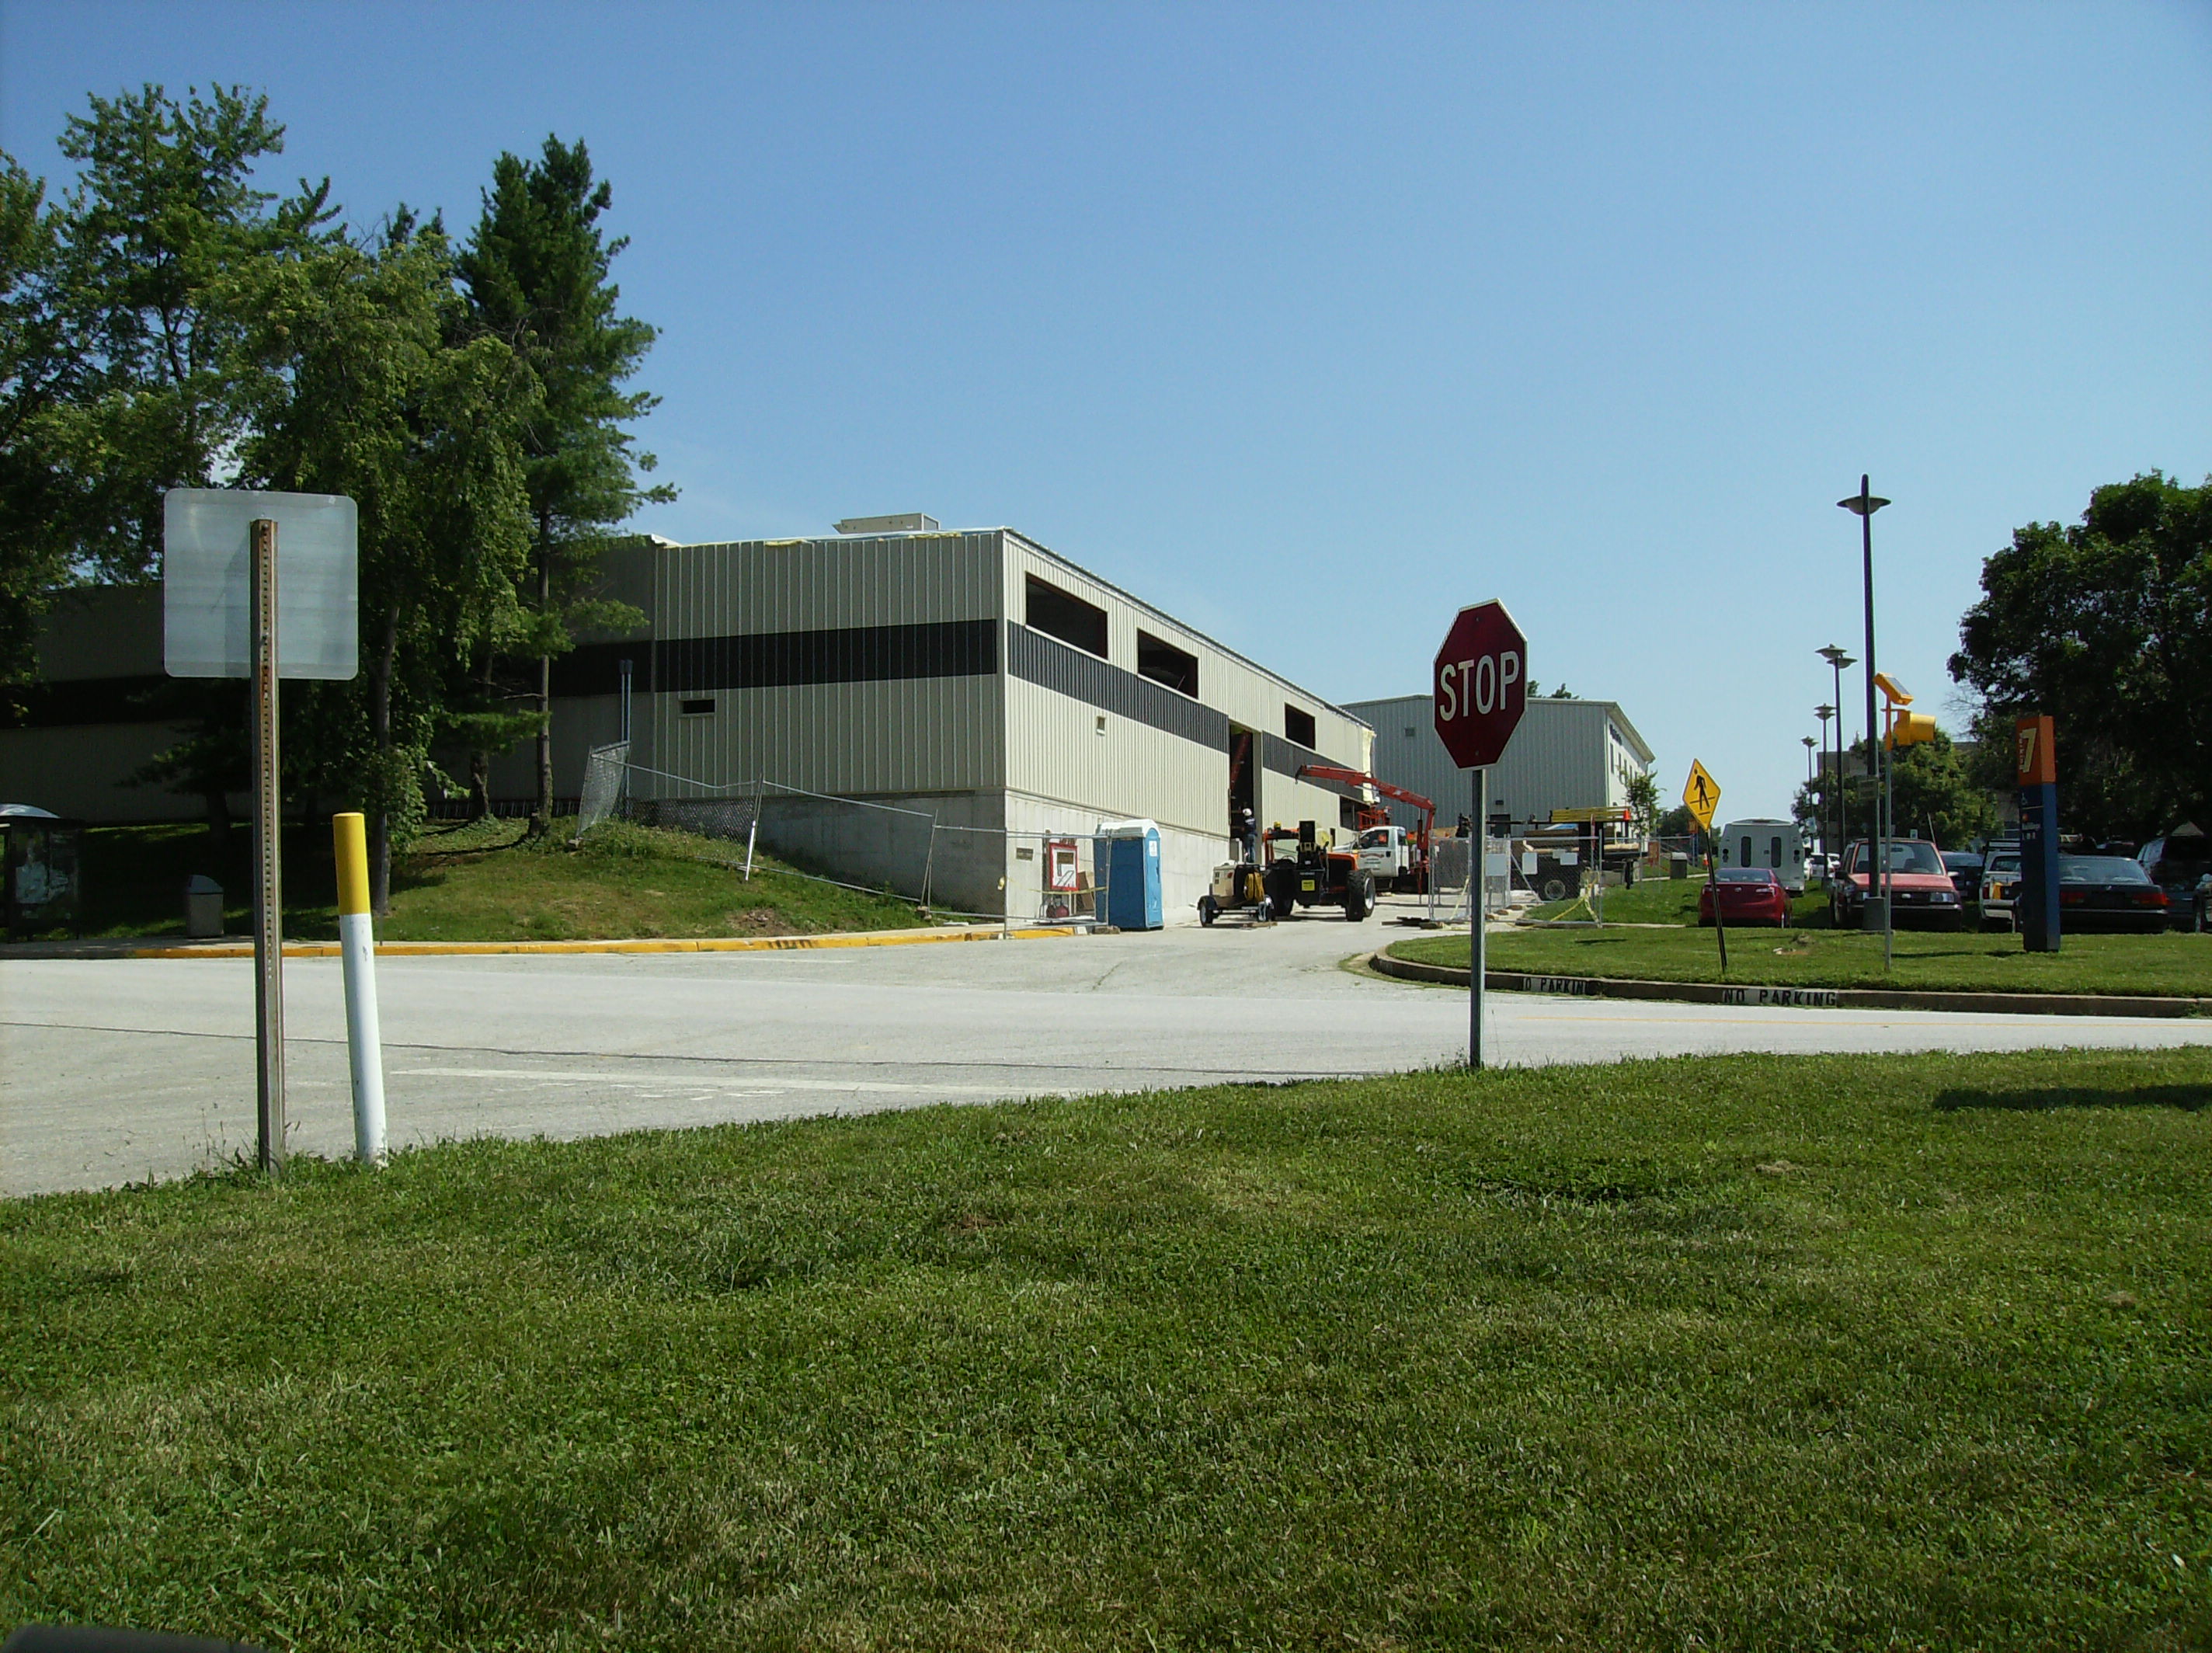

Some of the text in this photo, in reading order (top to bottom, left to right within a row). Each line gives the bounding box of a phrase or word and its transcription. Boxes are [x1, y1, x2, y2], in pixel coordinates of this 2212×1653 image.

[1439, 650, 1520, 722] STOP
[2022, 727, 2037, 773] 7
[1540, 977, 1587, 995] PARKIN
[1723, 988, 1837, 1007] NO PARKING
